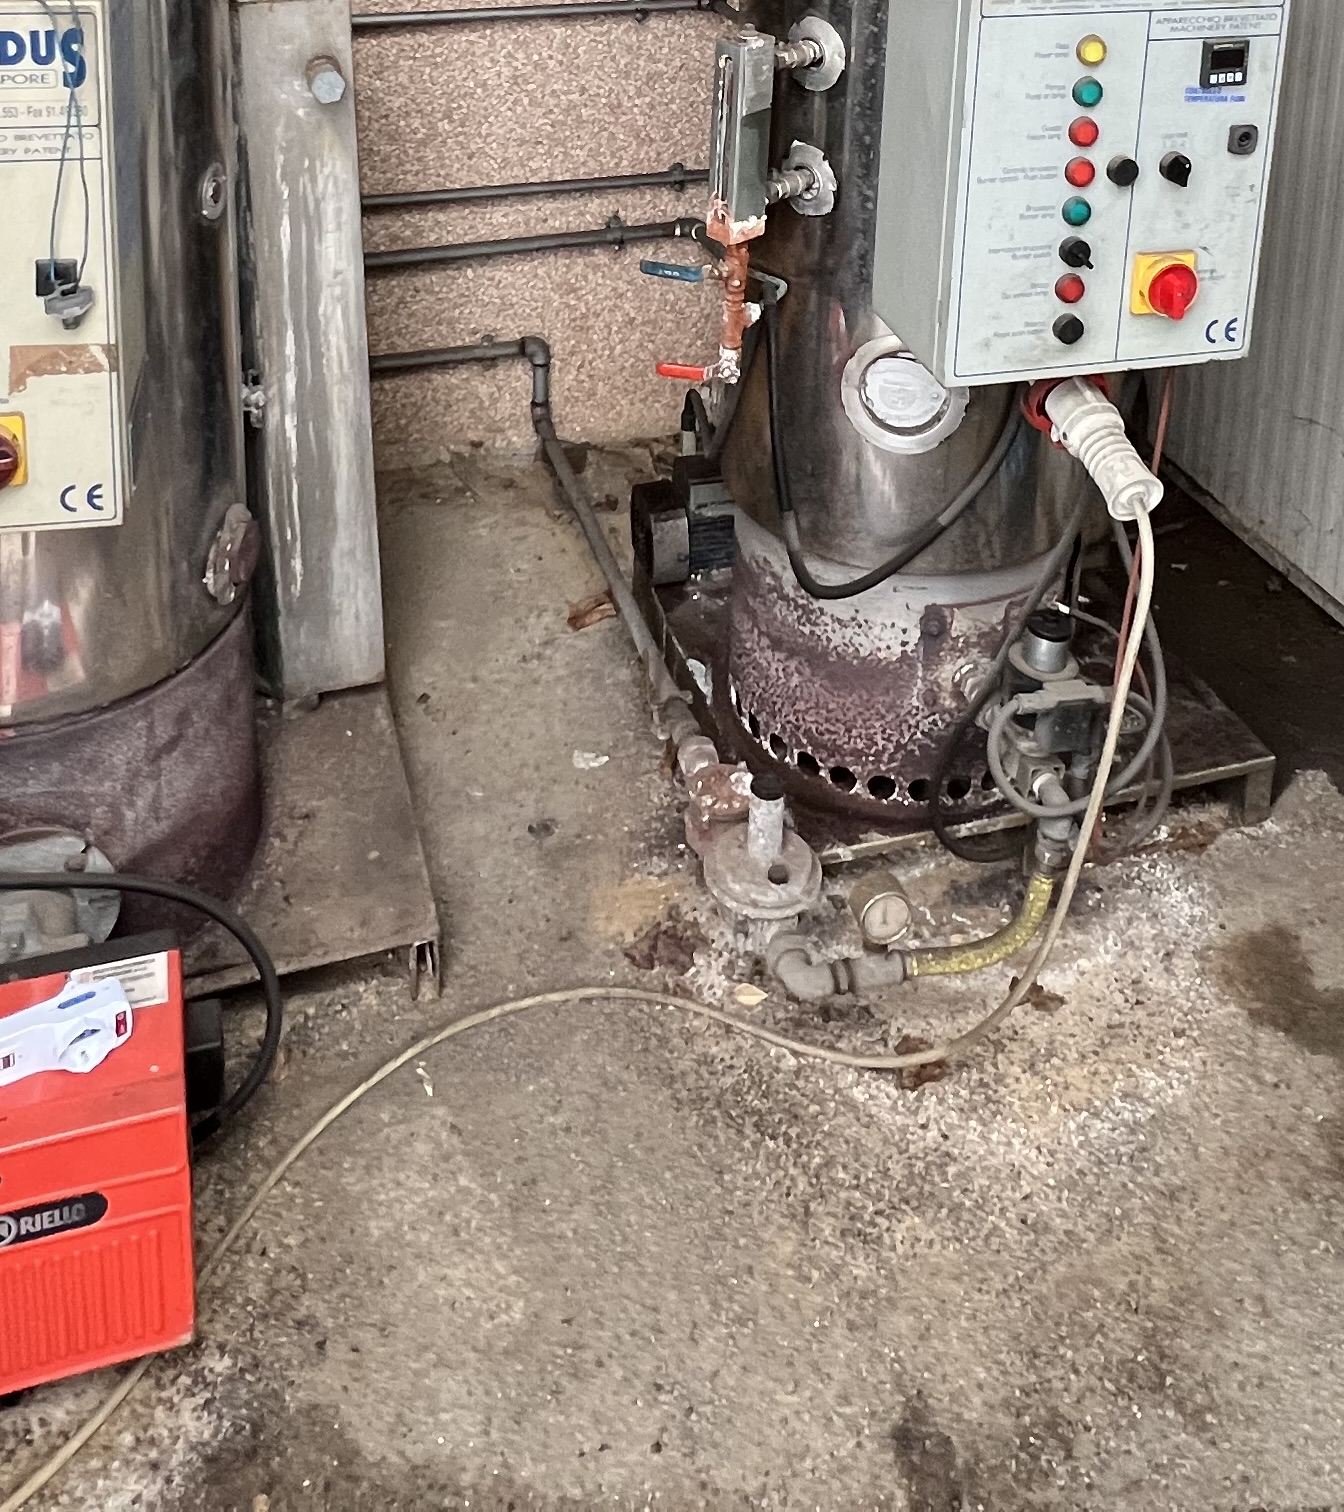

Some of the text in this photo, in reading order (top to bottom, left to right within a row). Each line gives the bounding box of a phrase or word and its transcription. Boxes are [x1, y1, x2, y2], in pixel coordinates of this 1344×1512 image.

[1205, 317, 1238, 344] CE
[60, 483, 104, 512] CE
[19, 1202, 86, 1236] RIELLO
